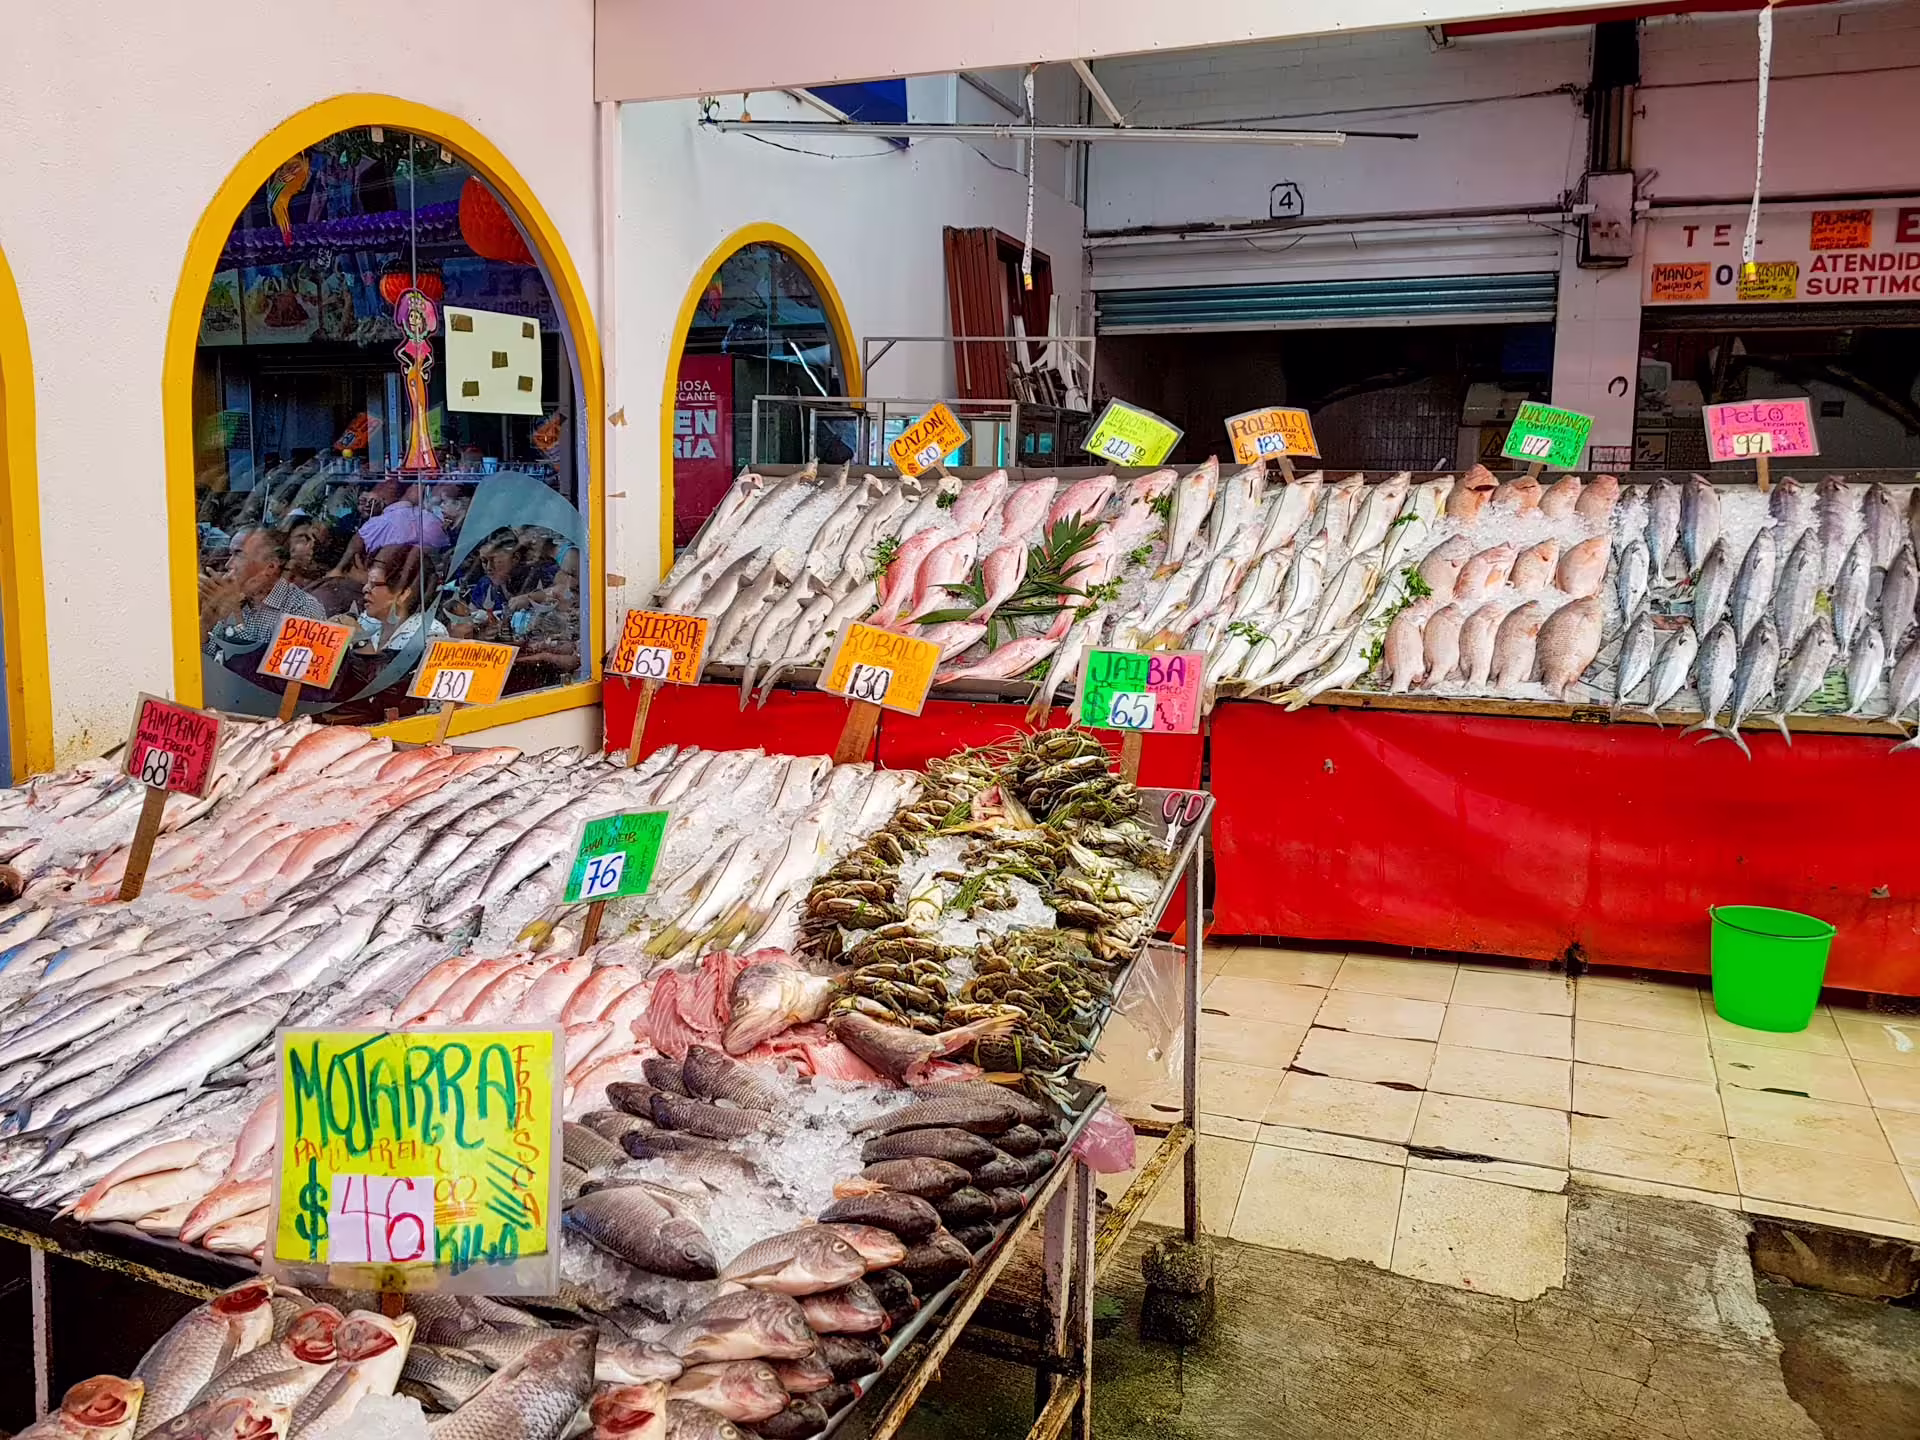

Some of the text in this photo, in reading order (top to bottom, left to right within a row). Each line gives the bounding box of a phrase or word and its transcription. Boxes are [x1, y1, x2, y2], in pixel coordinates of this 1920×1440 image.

[1279, 191, 1294, 210] 4
[1229, 412, 1304, 439] ROBALO
[279, 617, 339, 649] BAGRE
[628, 613, 699, 650] SIERRA
[846, 623, 929, 662] ROBALO
[282, 647, 309, 677] 47
[428, 643, 508, 668] HUACHINANGO
[635, 648, 667, 678] 65
[1091, 651, 1187, 687] JAIBA
[432, 670, 466, 699] 130
[847, 664, 890, 701] 130
[1111, 693, 1150, 730] 65
[142, 749, 169, 787] 68
[586, 855, 623, 894] 76
[340, 1175, 425, 1264] 46
